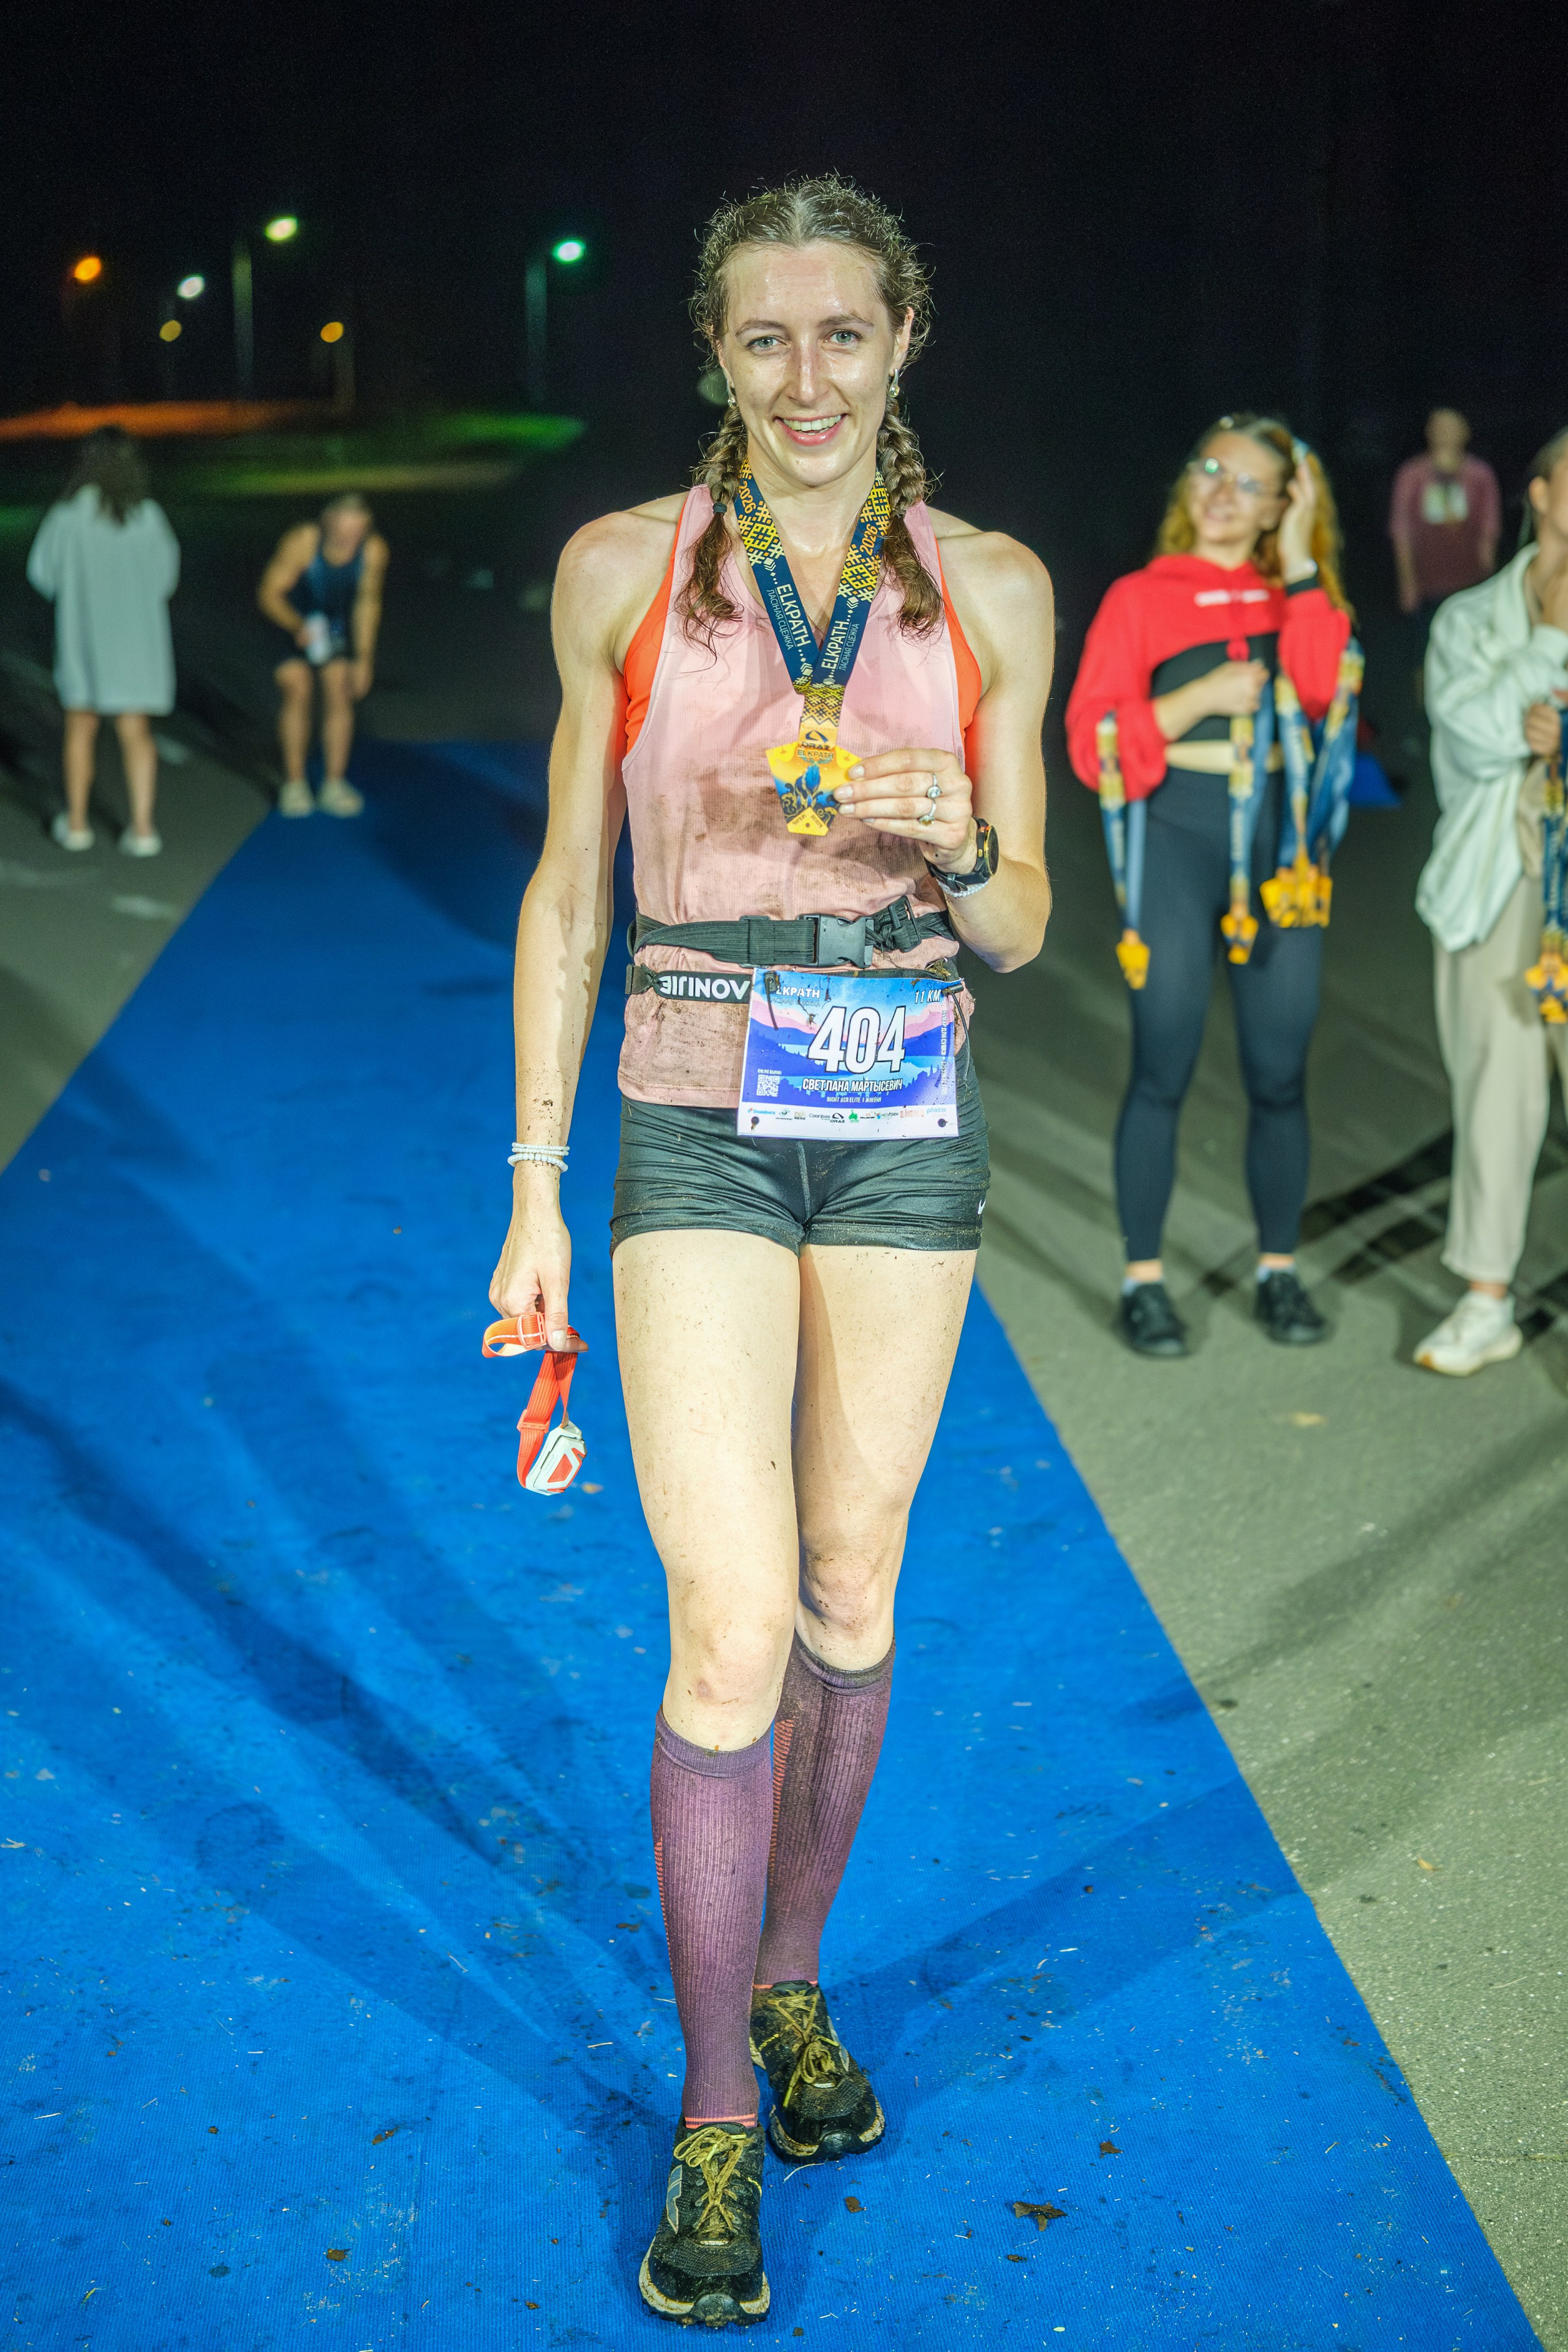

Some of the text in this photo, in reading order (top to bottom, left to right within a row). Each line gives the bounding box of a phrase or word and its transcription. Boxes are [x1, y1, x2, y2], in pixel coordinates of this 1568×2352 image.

[738, 480, 756, 514] 2026
[859, 522, 878, 556] 2026
[766, 589, 794, 650] ЛАСІНАЯ СЦЕЖКА
[775, 583, 812, 647] ELKPATH
[821, 620, 850, 669] ELKPATH
[846, 624, 859, 647] СЦЕЖКА
[797, 749, 834, 760] ELKPATH
[775, 986, 821, 999] LKPATH
[914, 989, 942, 1004] 11 KM
[807, 1005, 907, 1074] 404
[802, 1077, 903, 1092] СВЕТЛАНА МАРТЫСЕВИЧ
